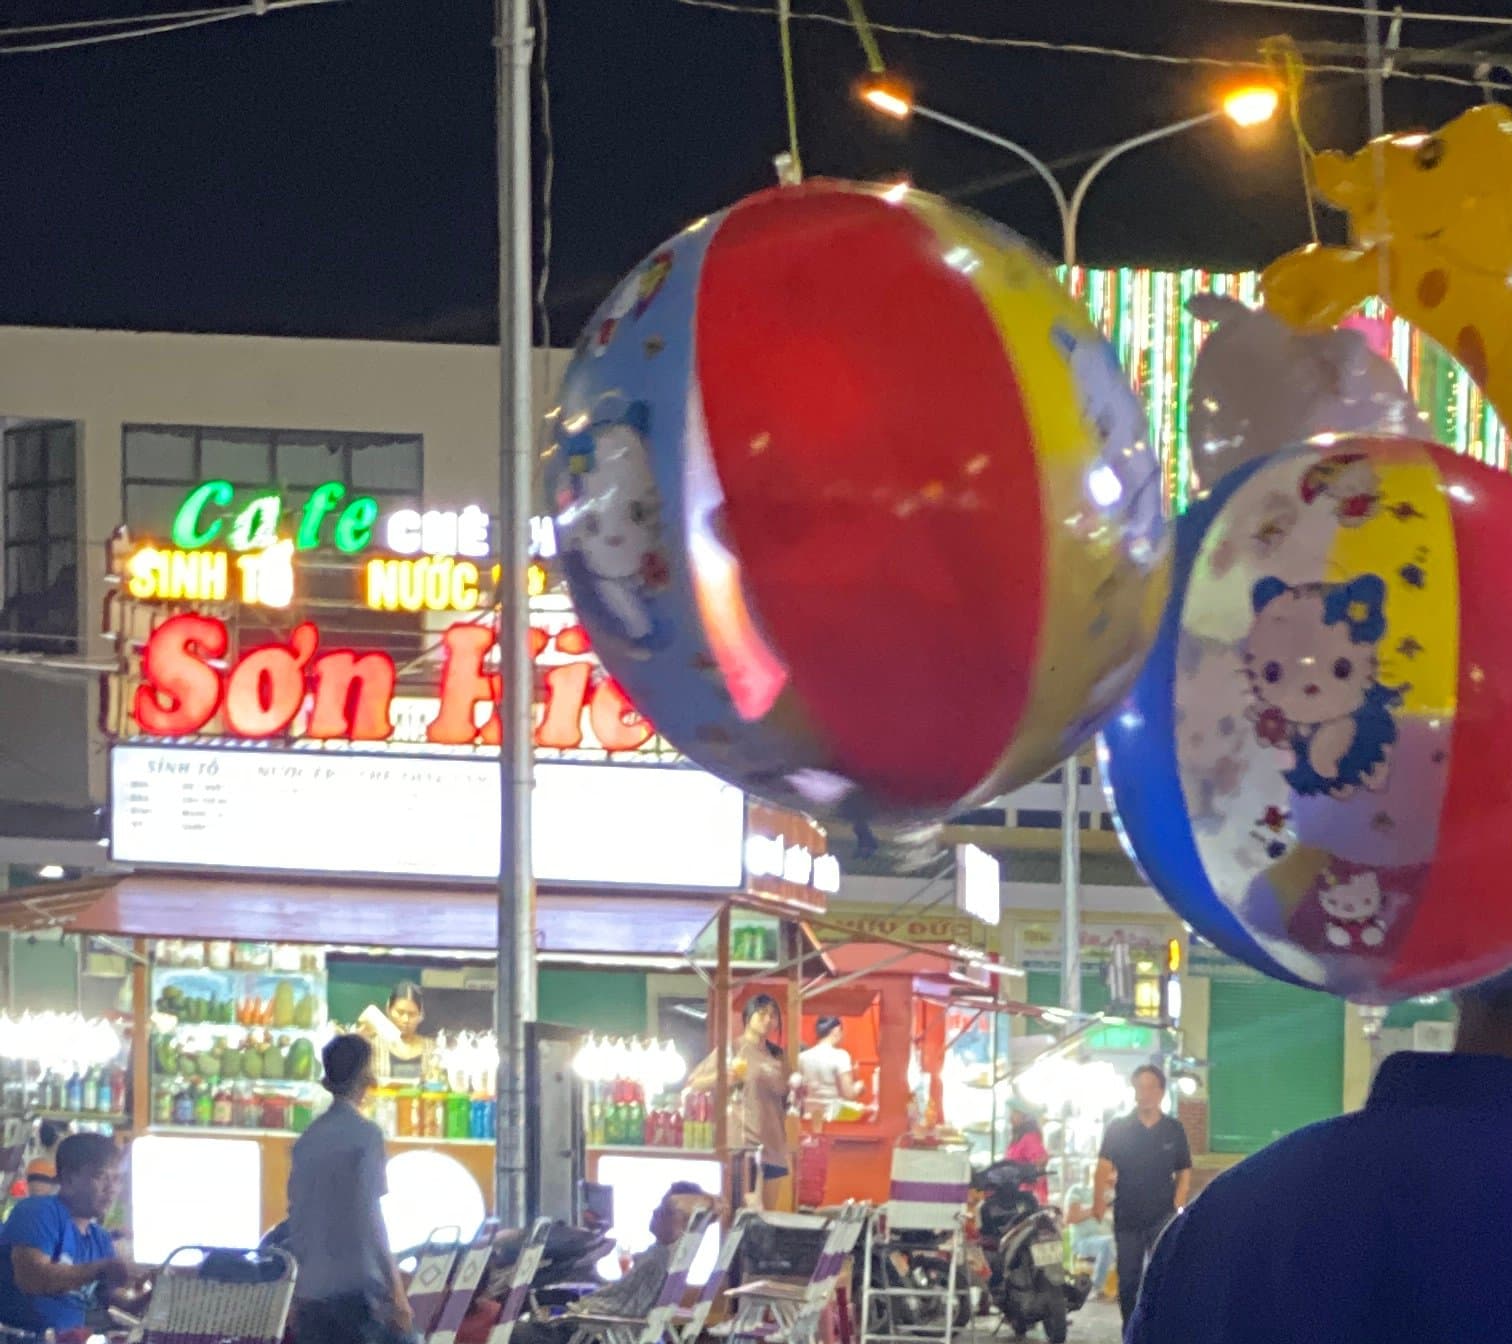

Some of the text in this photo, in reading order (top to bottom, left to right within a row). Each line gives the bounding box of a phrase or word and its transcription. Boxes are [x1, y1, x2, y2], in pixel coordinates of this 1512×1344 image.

[173, 479, 378, 553] Cafe
[129, 548, 228, 599] SINH
[133, 612, 396, 738] Sơn
